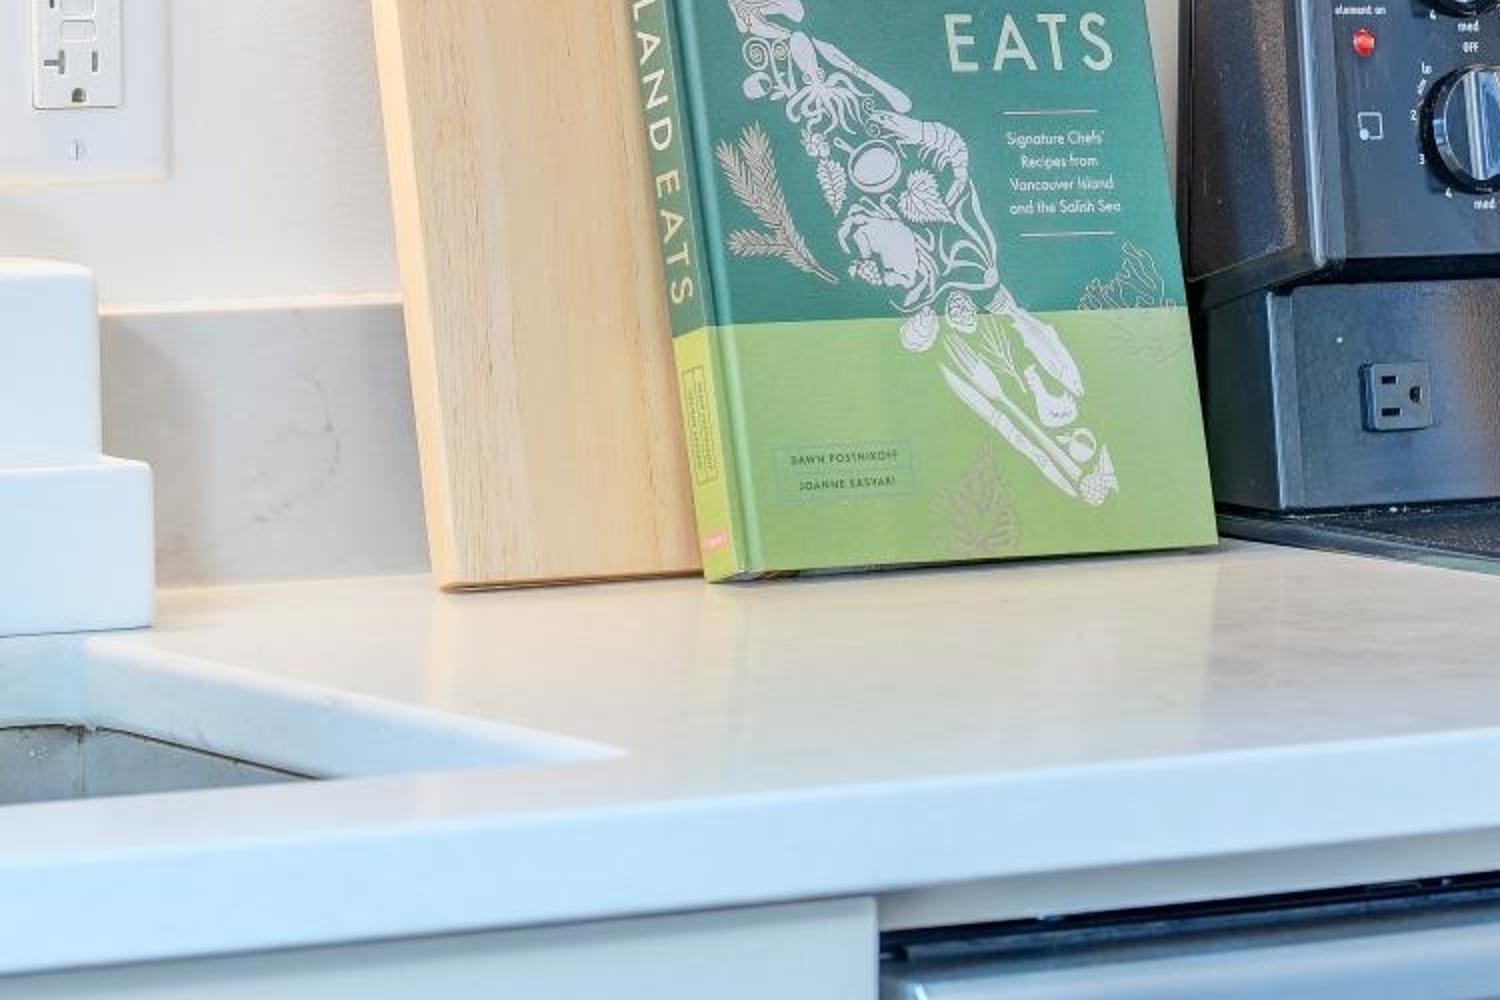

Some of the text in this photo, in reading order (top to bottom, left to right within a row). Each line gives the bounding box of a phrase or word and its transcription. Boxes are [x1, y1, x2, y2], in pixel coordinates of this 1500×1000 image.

[943, 10, 1114, 73] EATS
[1006, 131, 1065, 149] Signature
[1021, 152, 1099, 171] Recipes from
[1009, 172, 1115, 191] Vancouver Island
[1009, 200, 1034, 215] and
[1037, 200, 1057, 214] the
[1096, 199, 1121, 213] Sea
[655, 168, 695, 306] EATS
